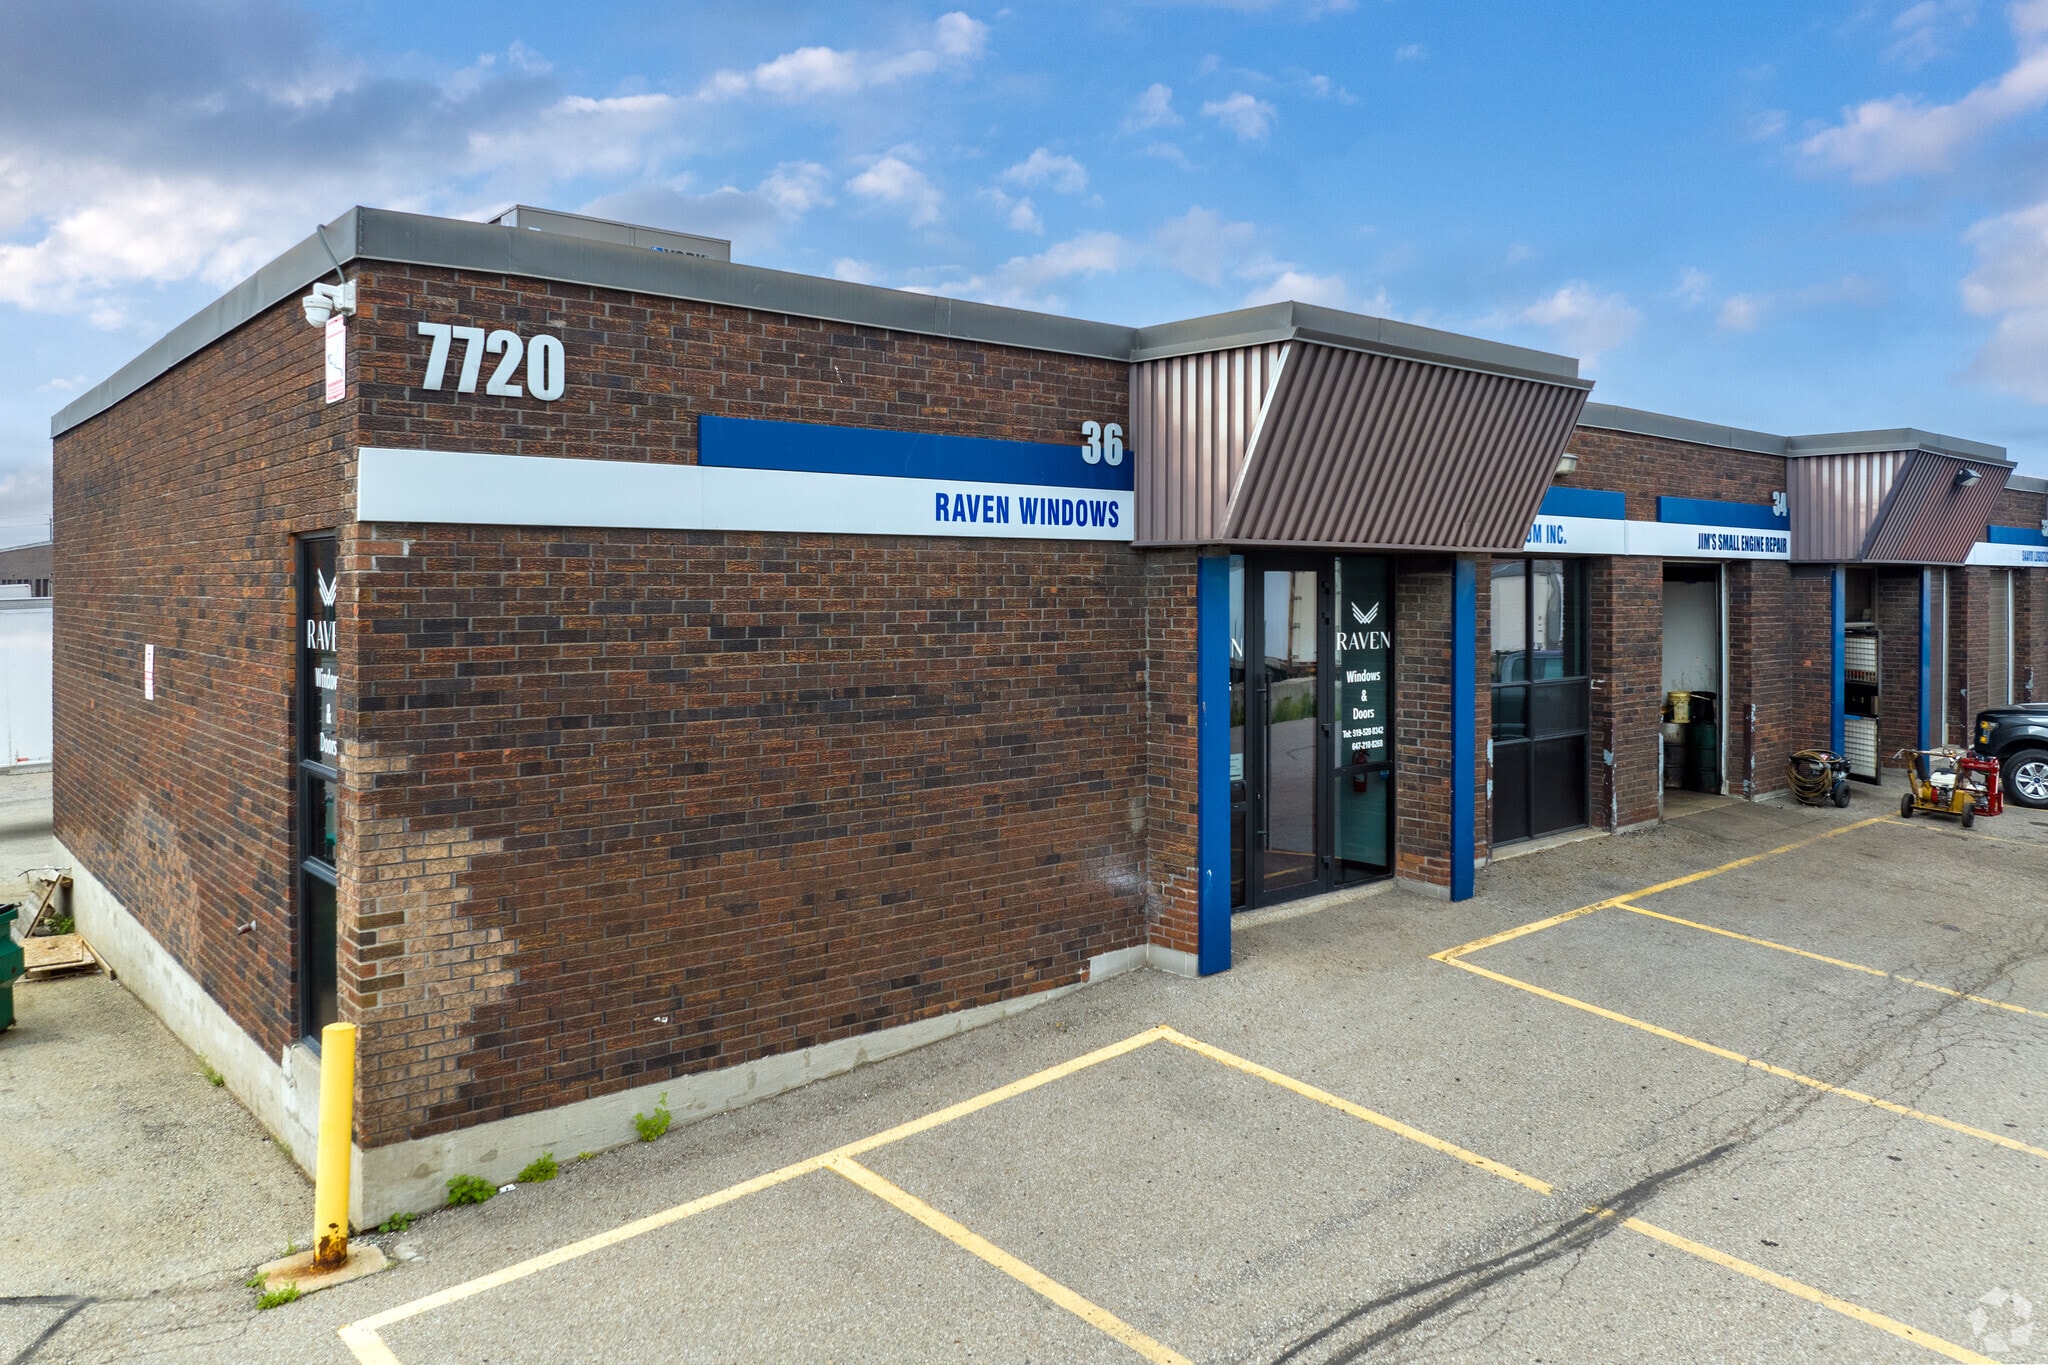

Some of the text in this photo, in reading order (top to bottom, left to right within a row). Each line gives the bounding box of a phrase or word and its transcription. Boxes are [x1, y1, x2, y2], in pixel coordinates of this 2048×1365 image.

[418, 322, 565, 401] 7720
[1082, 420, 1123, 466] 36
[935, 492, 1119, 528] RAVEN WINDOWS
[1772, 491, 1788, 517] 34
[1546, 524, 1567, 544] INC.
[1697, 532, 1787, 553] JIM'S SMALL ENGINE REPAIR
[307, 619, 337, 652] RAVE
[1336, 631, 1391, 651] RAVEN
[315, 667, 338, 690] Window
[1346, 669, 1381, 683] Windows
[1361, 689, 1368, 702] &
[1352, 707, 1375, 720] Doors
